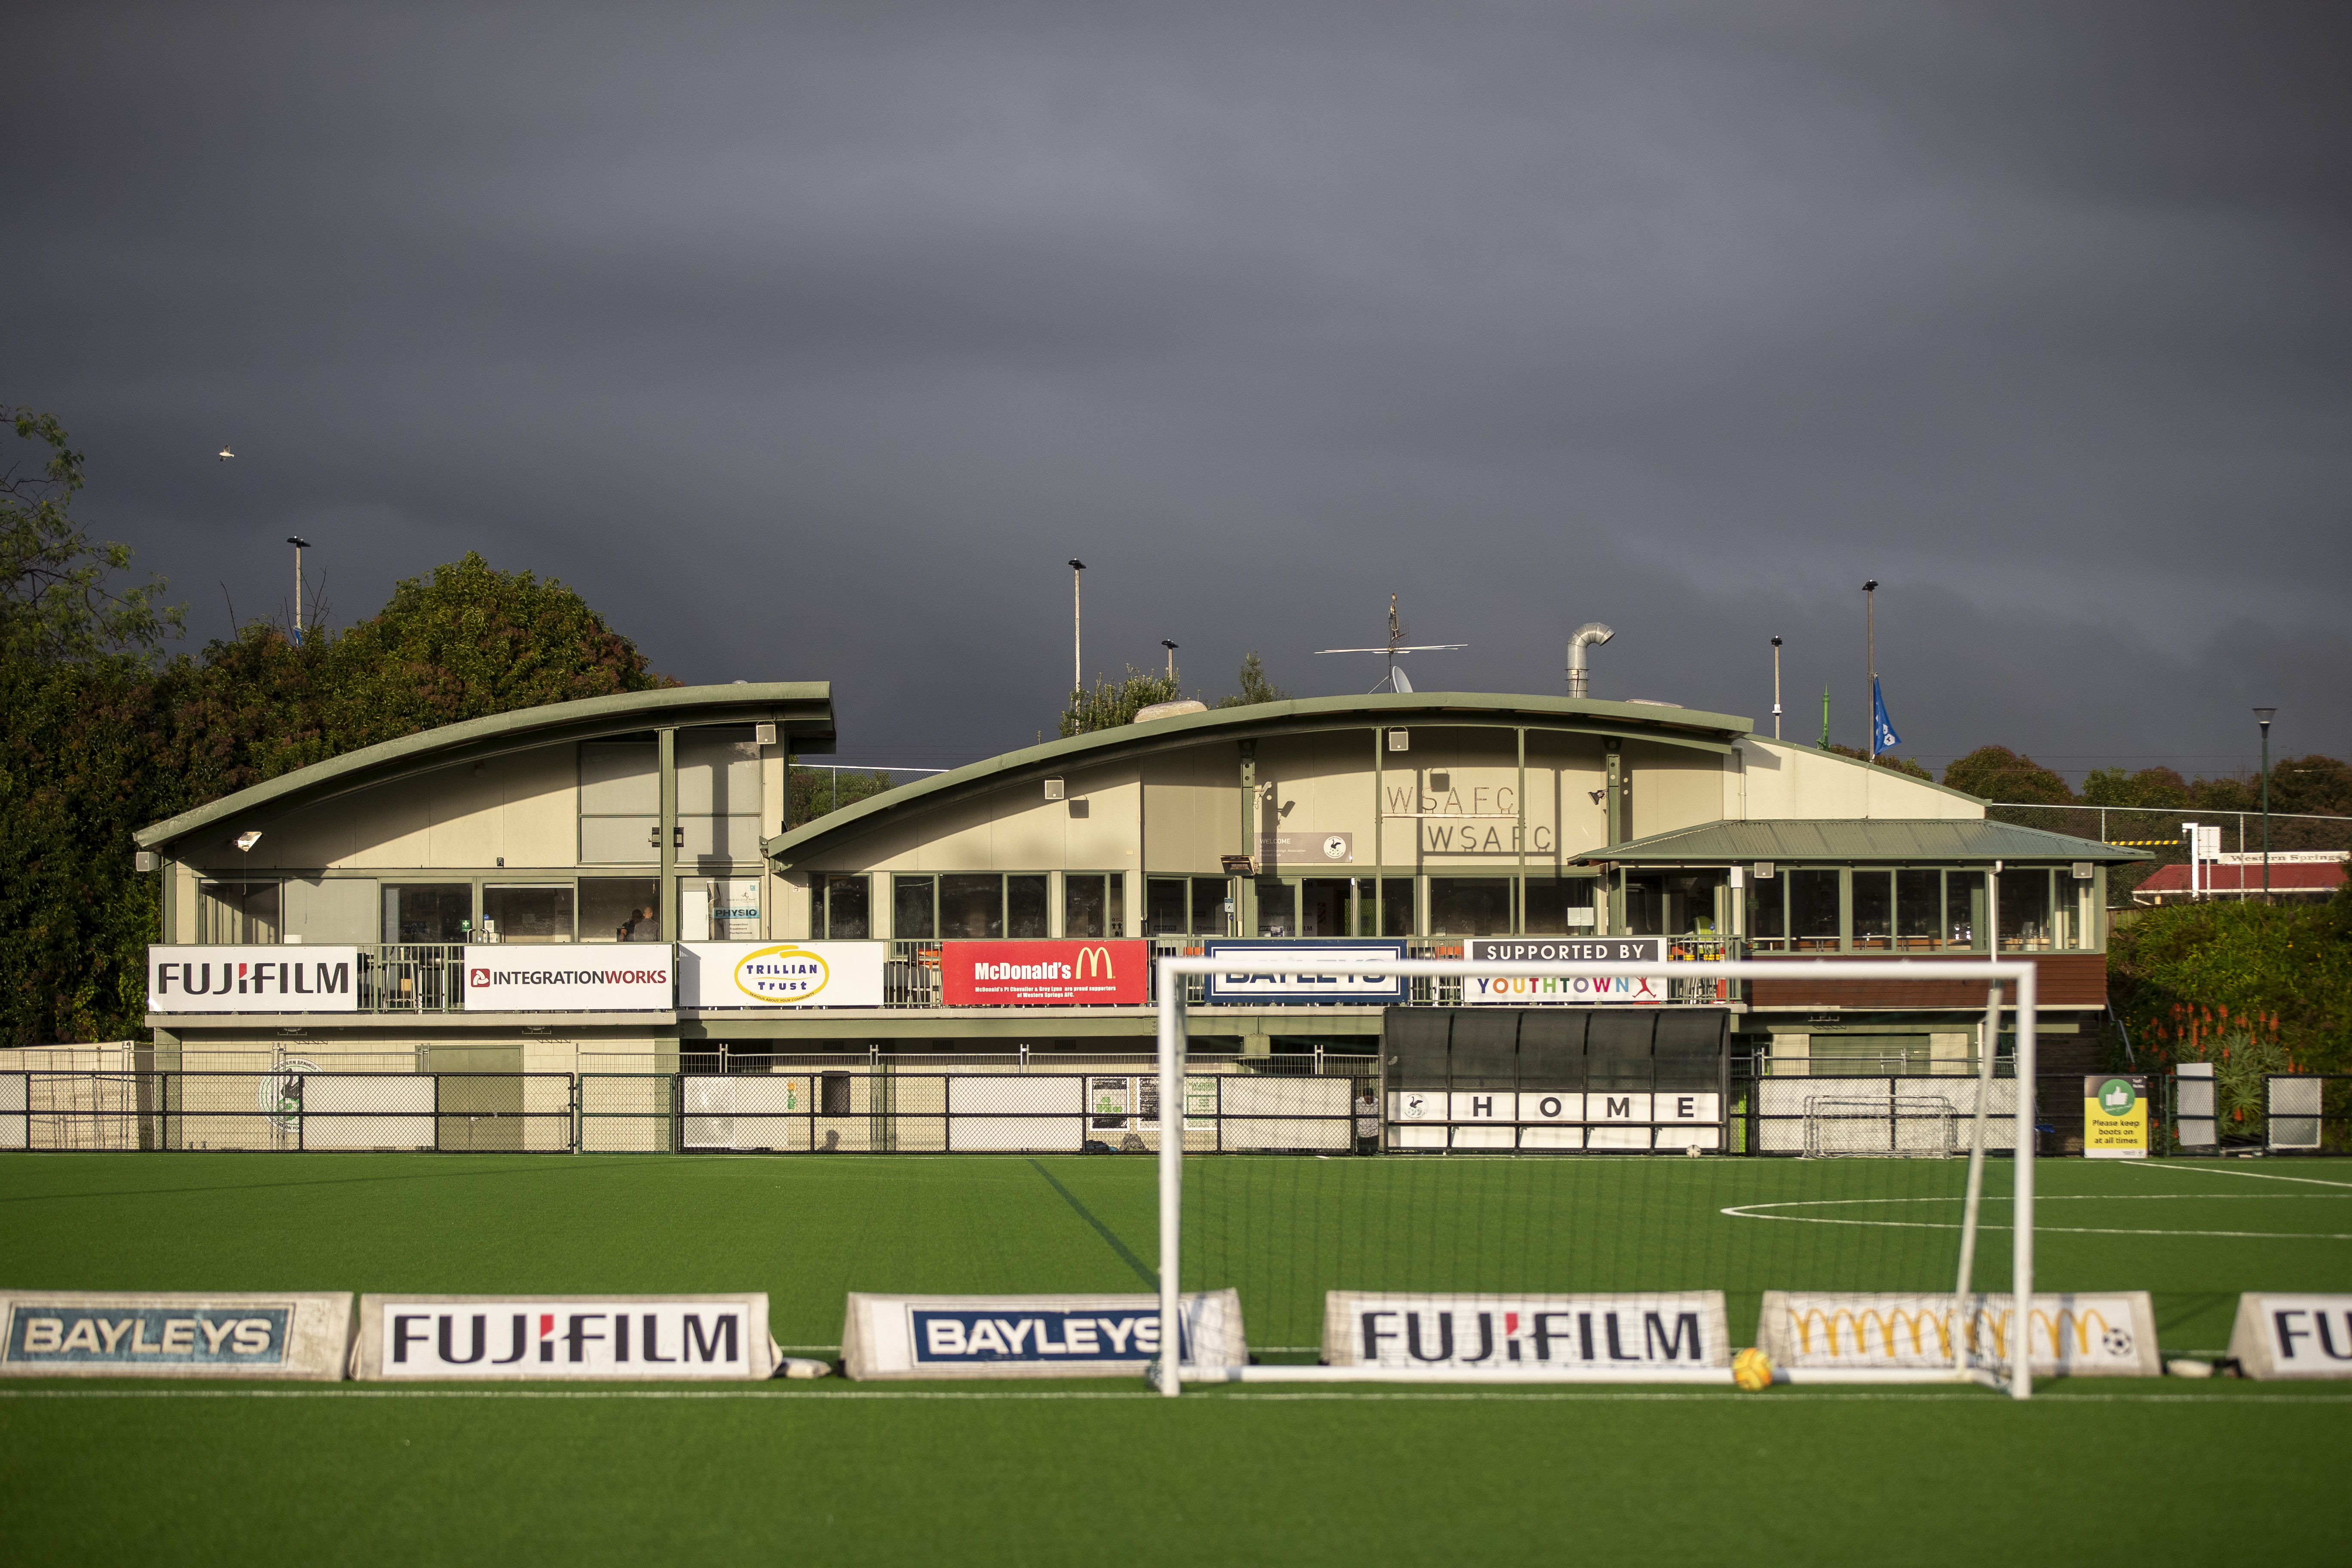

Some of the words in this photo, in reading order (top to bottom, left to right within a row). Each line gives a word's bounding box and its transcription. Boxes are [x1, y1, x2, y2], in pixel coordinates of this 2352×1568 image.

[1387, 787, 1513, 811] WSAFC
[1487, 945, 1608, 960] SUPPORTED
[1620, 944, 1644, 959] BY
[494, 971, 666, 984] INTEGRATIONWORKS
[747, 965, 817, 974] TRILLIAN
[975, 962, 1071, 980] McDonald's
[159, 963, 348, 994] FUJIFILM
[758, 982, 807, 990] Trust
[1477, 977, 1629, 994] YOUTHTOWN
[750, 992, 765, 1001] SERIOUS
[792, 992, 815, 1001] COMMUNITY
[297, 1060, 317, 1071] SPRINGS
[2120, 1120, 2140, 1128] keep
[24, 1318, 272, 1354] BAYLEYS
[393, 1313, 738, 1364] FUJIFILM
[926, 1317, 1162, 1355] BAYLEYS
[1361, 1312, 1701, 1361] FUJIFILM
